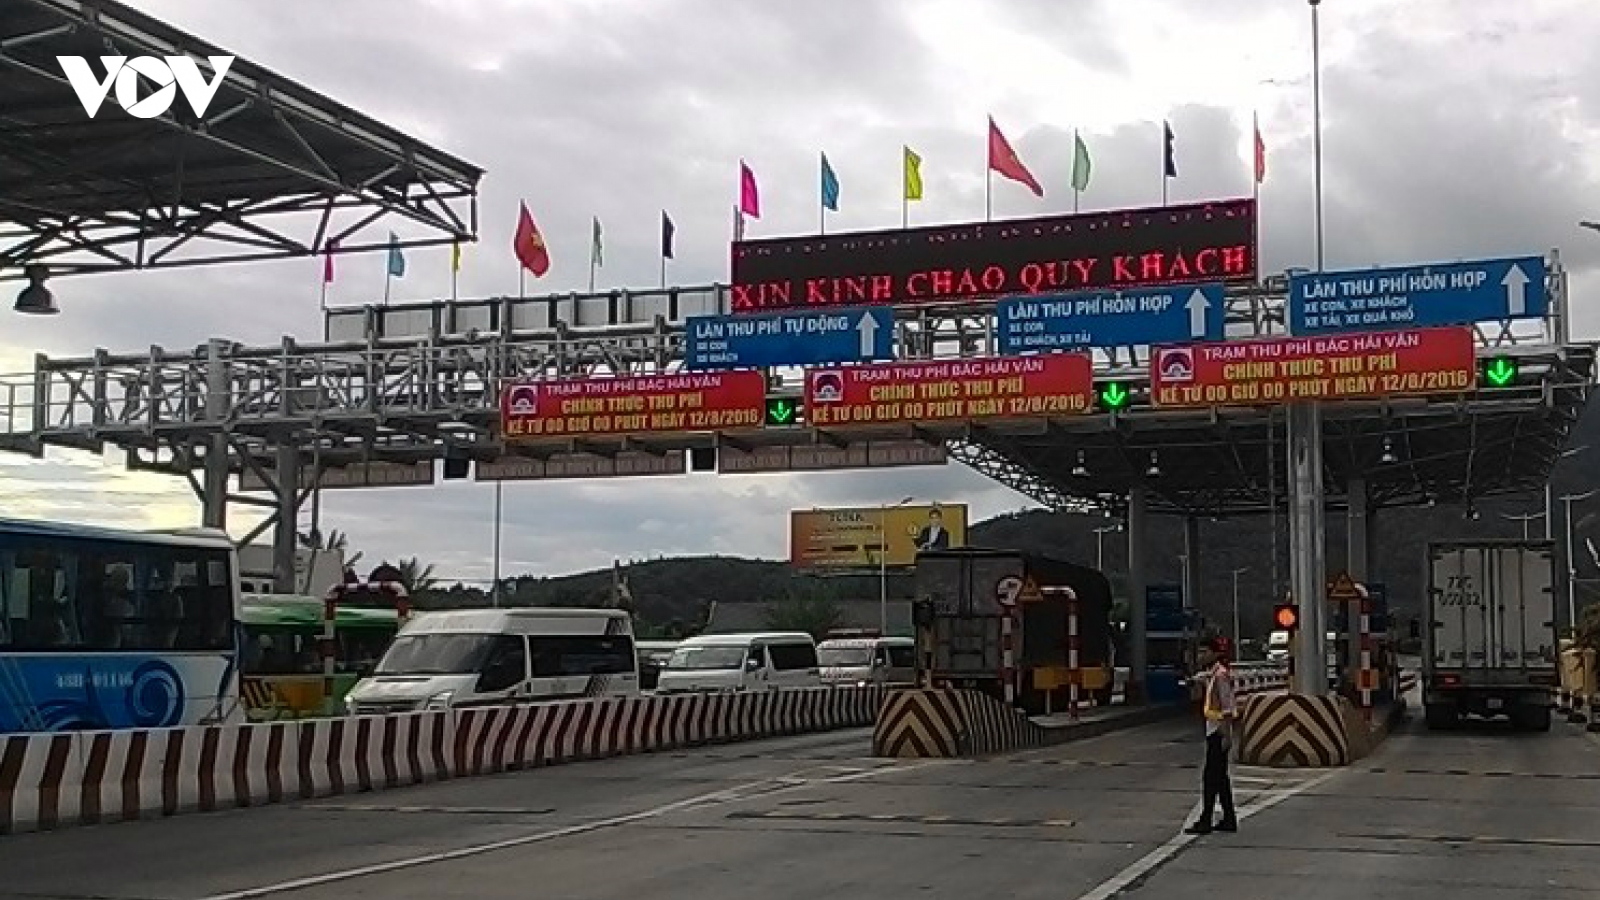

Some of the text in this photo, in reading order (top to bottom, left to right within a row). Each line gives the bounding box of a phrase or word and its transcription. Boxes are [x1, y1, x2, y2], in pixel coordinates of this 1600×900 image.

[1340, 278, 1374, 296] THU
[1378, 271, 1408, 293] PHÍ
[1451, 270, 1487, 292] HỢP
[733, 280, 791, 308] XIN
[1041, 301, 1072, 318] THU
[1075, 295, 1102, 315] PHÍ
[727, 321, 754, 337] THU
[758, 317, 781, 335] PHÍ
[1249, 344, 1280, 356] THU
[1285, 340, 1311, 354] PHÍ
[894, 367, 922, 379] THU
[925, 364, 949, 378] PHÍ
[1328, 355, 1362, 373] THU
[1367, 352, 1396, 371] PHÍ
[963, 379, 992, 396] THU
[998, 375, 1023, 394] PHÍ
[647, 393, 675, 410] THU
